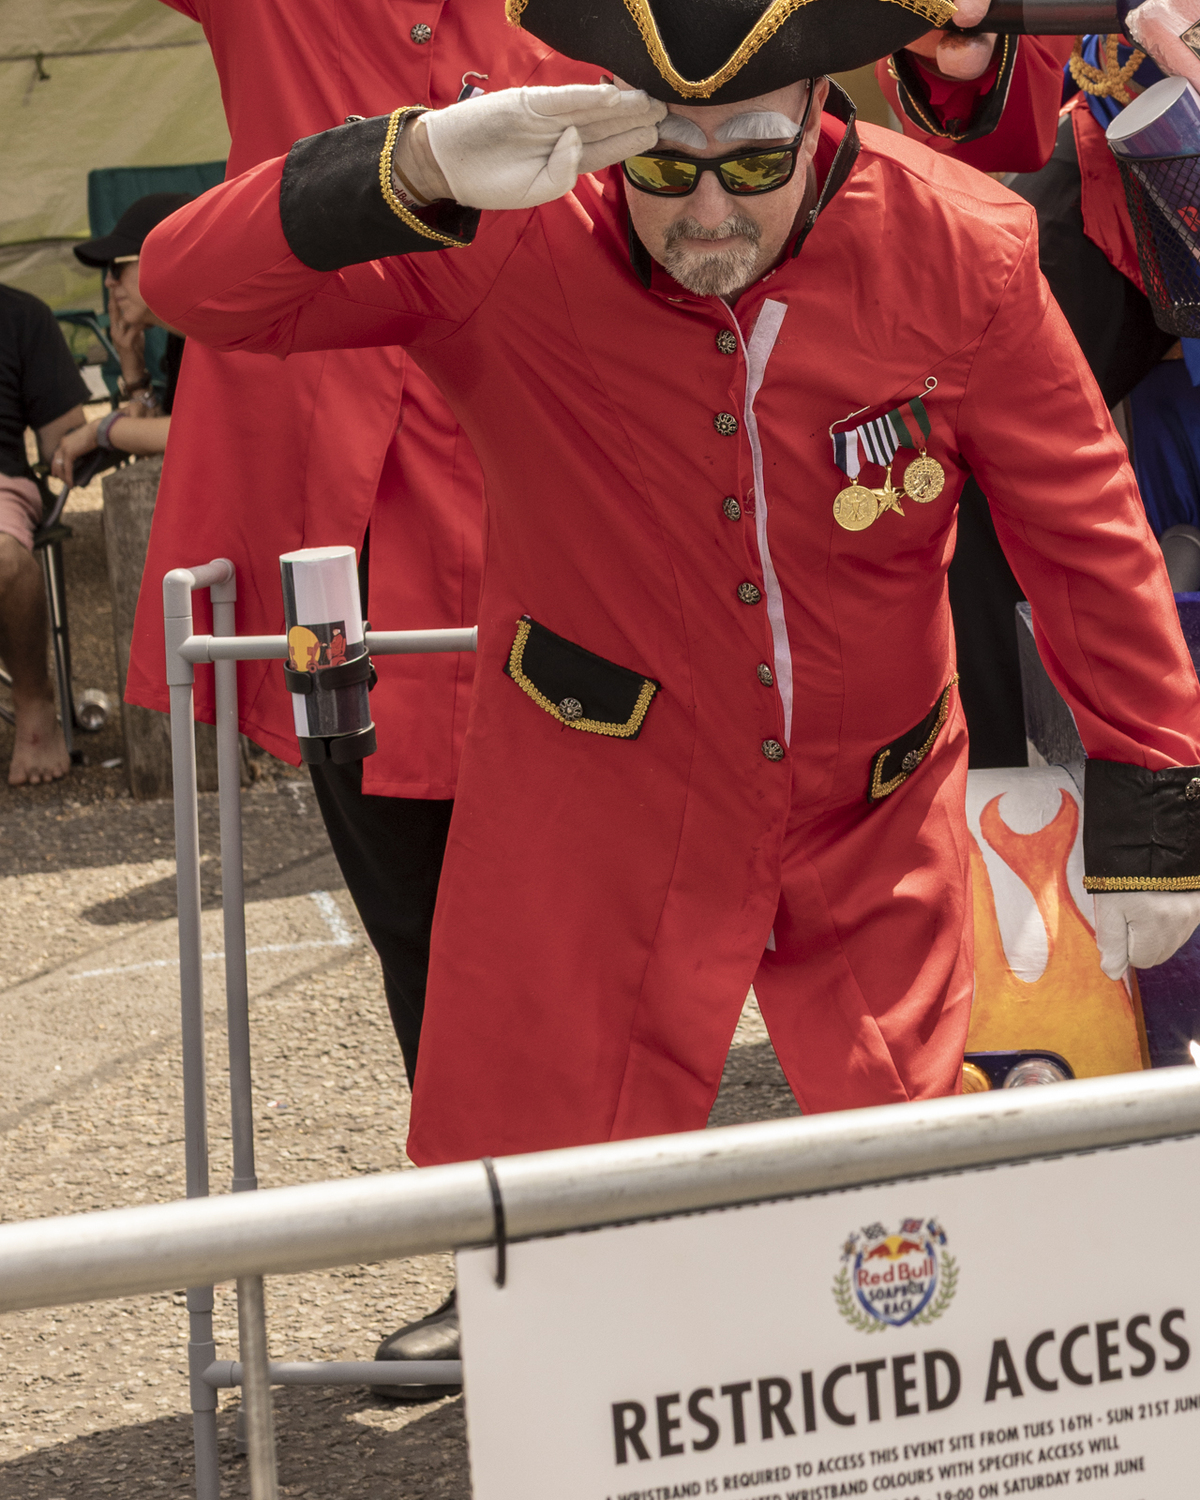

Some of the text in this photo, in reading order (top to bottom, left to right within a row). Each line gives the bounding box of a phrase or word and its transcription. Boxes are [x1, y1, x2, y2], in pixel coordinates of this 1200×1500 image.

[857, 1257, 934, 1287] Red Bull
[869, 1282, 924, 1302] SOAPBOX
[884, 1300, 913, 1315] RACE
[611, 1307, 1191, 1466] RESTRICTED ACCESS
[705, 1475, 719, 1495] IS
[723, 1465, 791, 1490] REQUIRED
[795, 1461, 813, 1479] TO
[817, 1451, 866, 1475] ACCESS
[869, 1445, 899, 1467] THIS
[903, 1437, 944, 1461] EVENT
[949, 1432, 975, 1454] SITE
[980, 1425, 1020, 1447] FROM
[1023, 1419, 1055, 1441] TUES
[1060, 1414, 1093, 1434] 16TH
[1106, 1406, 1134, 1425] SUN
[1138, 1400, 1169, 1419] 21ST
[785, 1433, 1120, 1500] WRISTBAND COLOURS WITH SPECIFIC ACCESS WILL
[978, 1481, 999, 1499] ON
[1003, 1468, 1070, 1496] SATURDAY
[1074, 1462, 1110, 1484] 20TH
[1113, 1456, 1145, 1477] JUNE
